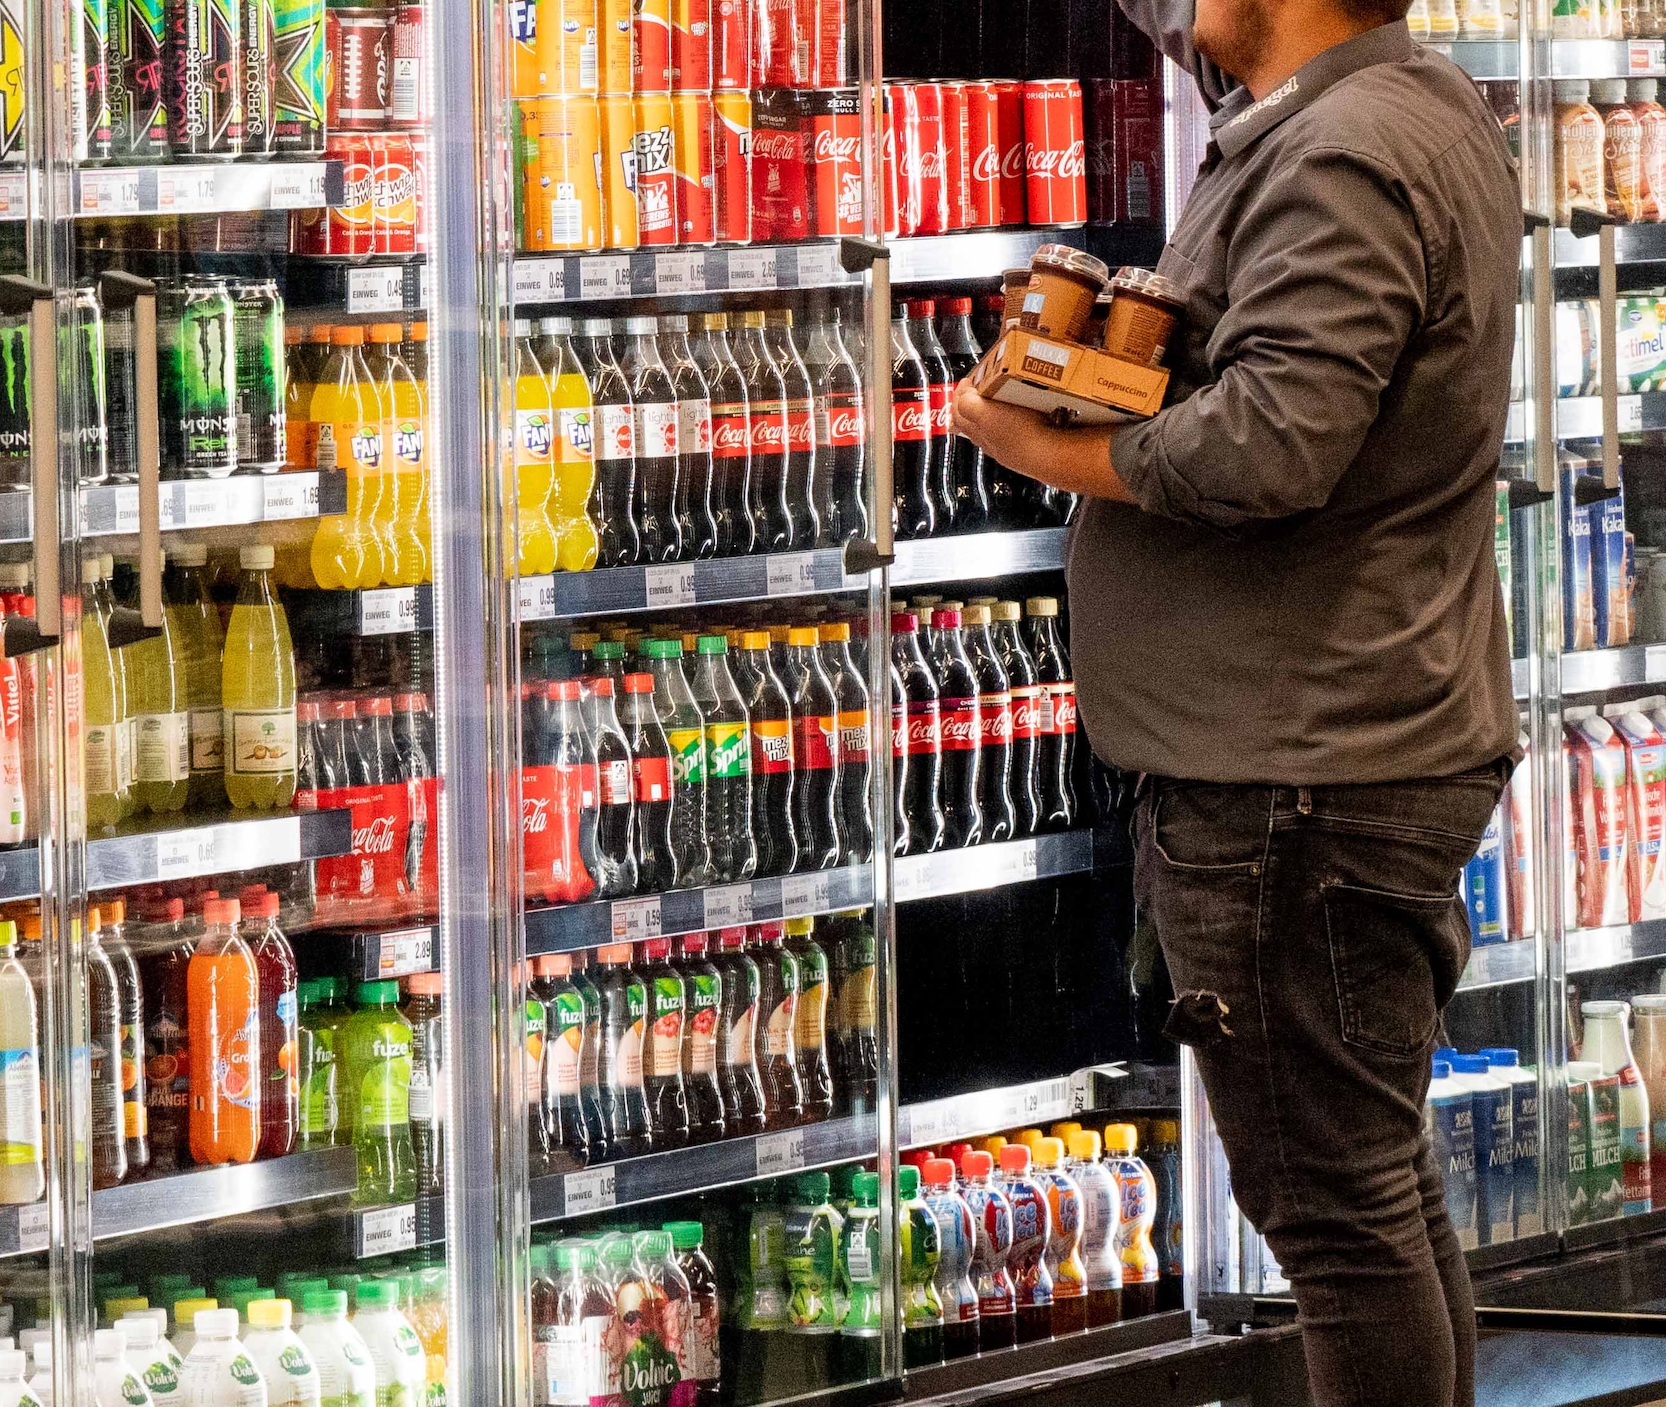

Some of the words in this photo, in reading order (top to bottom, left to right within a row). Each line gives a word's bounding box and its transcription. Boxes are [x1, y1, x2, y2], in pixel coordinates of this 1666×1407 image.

[187, 3, 199, 48] ENERGY
[248, 4, 259, 46] ENERGY
[827, 98, 854, 108] ZERO
[1026, 90, 1066, 100] ORIGINAL
[121, 184, 139, 202] 1.79
[274, 186, 301, 196] EINWEG
[309, 177, 326, 195] 1.19
[615, 268, 631, 285] 0.69
[689, 264, 705, 281] 0.69
[731, 269, 755, 279] EINWEG
[761, 261, 776, 277] 2.69
[516, 281, 541, 291] EINWEG
[549, 271, 564, 288] 0.69
[583, 277, 608, 287] EINWEG
[658, 273, 683, 283] EINWEG
[352, 289, 379, 300] EINWEG
[387, 279, 403, 297] 0.49
[1623, 334, 1664, 359] ctimel
[1025, 358, 1061, 379] COFFEE
[1097, 375, 1148, 399] Cappuccino
[267, 496, 294, 507] EINWEG
[303, 485, 319, 504] 1.69
[539, 588, 555, 604] 0.99
[648, 585, 673, 594] EINWEG
[365, 611, 390, 621] EINWEG
[398, 600, 415, 618] 0.99
[6, 673, 18, 726] Vittel
[645, 909, 661, 926] 0.59
[415, 942, 431, 960] 2.89
[372, 1042, 408, 1057] fuze
[1023, 1095, 1037, 1111] 1.29
[1075, 1086, 1084, 1109] 1.29
[1592, 1146, 1620, 1167] MILCH
[600, 1178, 616, 1196] 0.95
[567, 1193, 593, 1203] EINWEG
[399, 1218, 416, 1235] 0.95
[365, 1230, 392, 1242] EINWEG
[624, 1349, 675, 1390] Volvic
